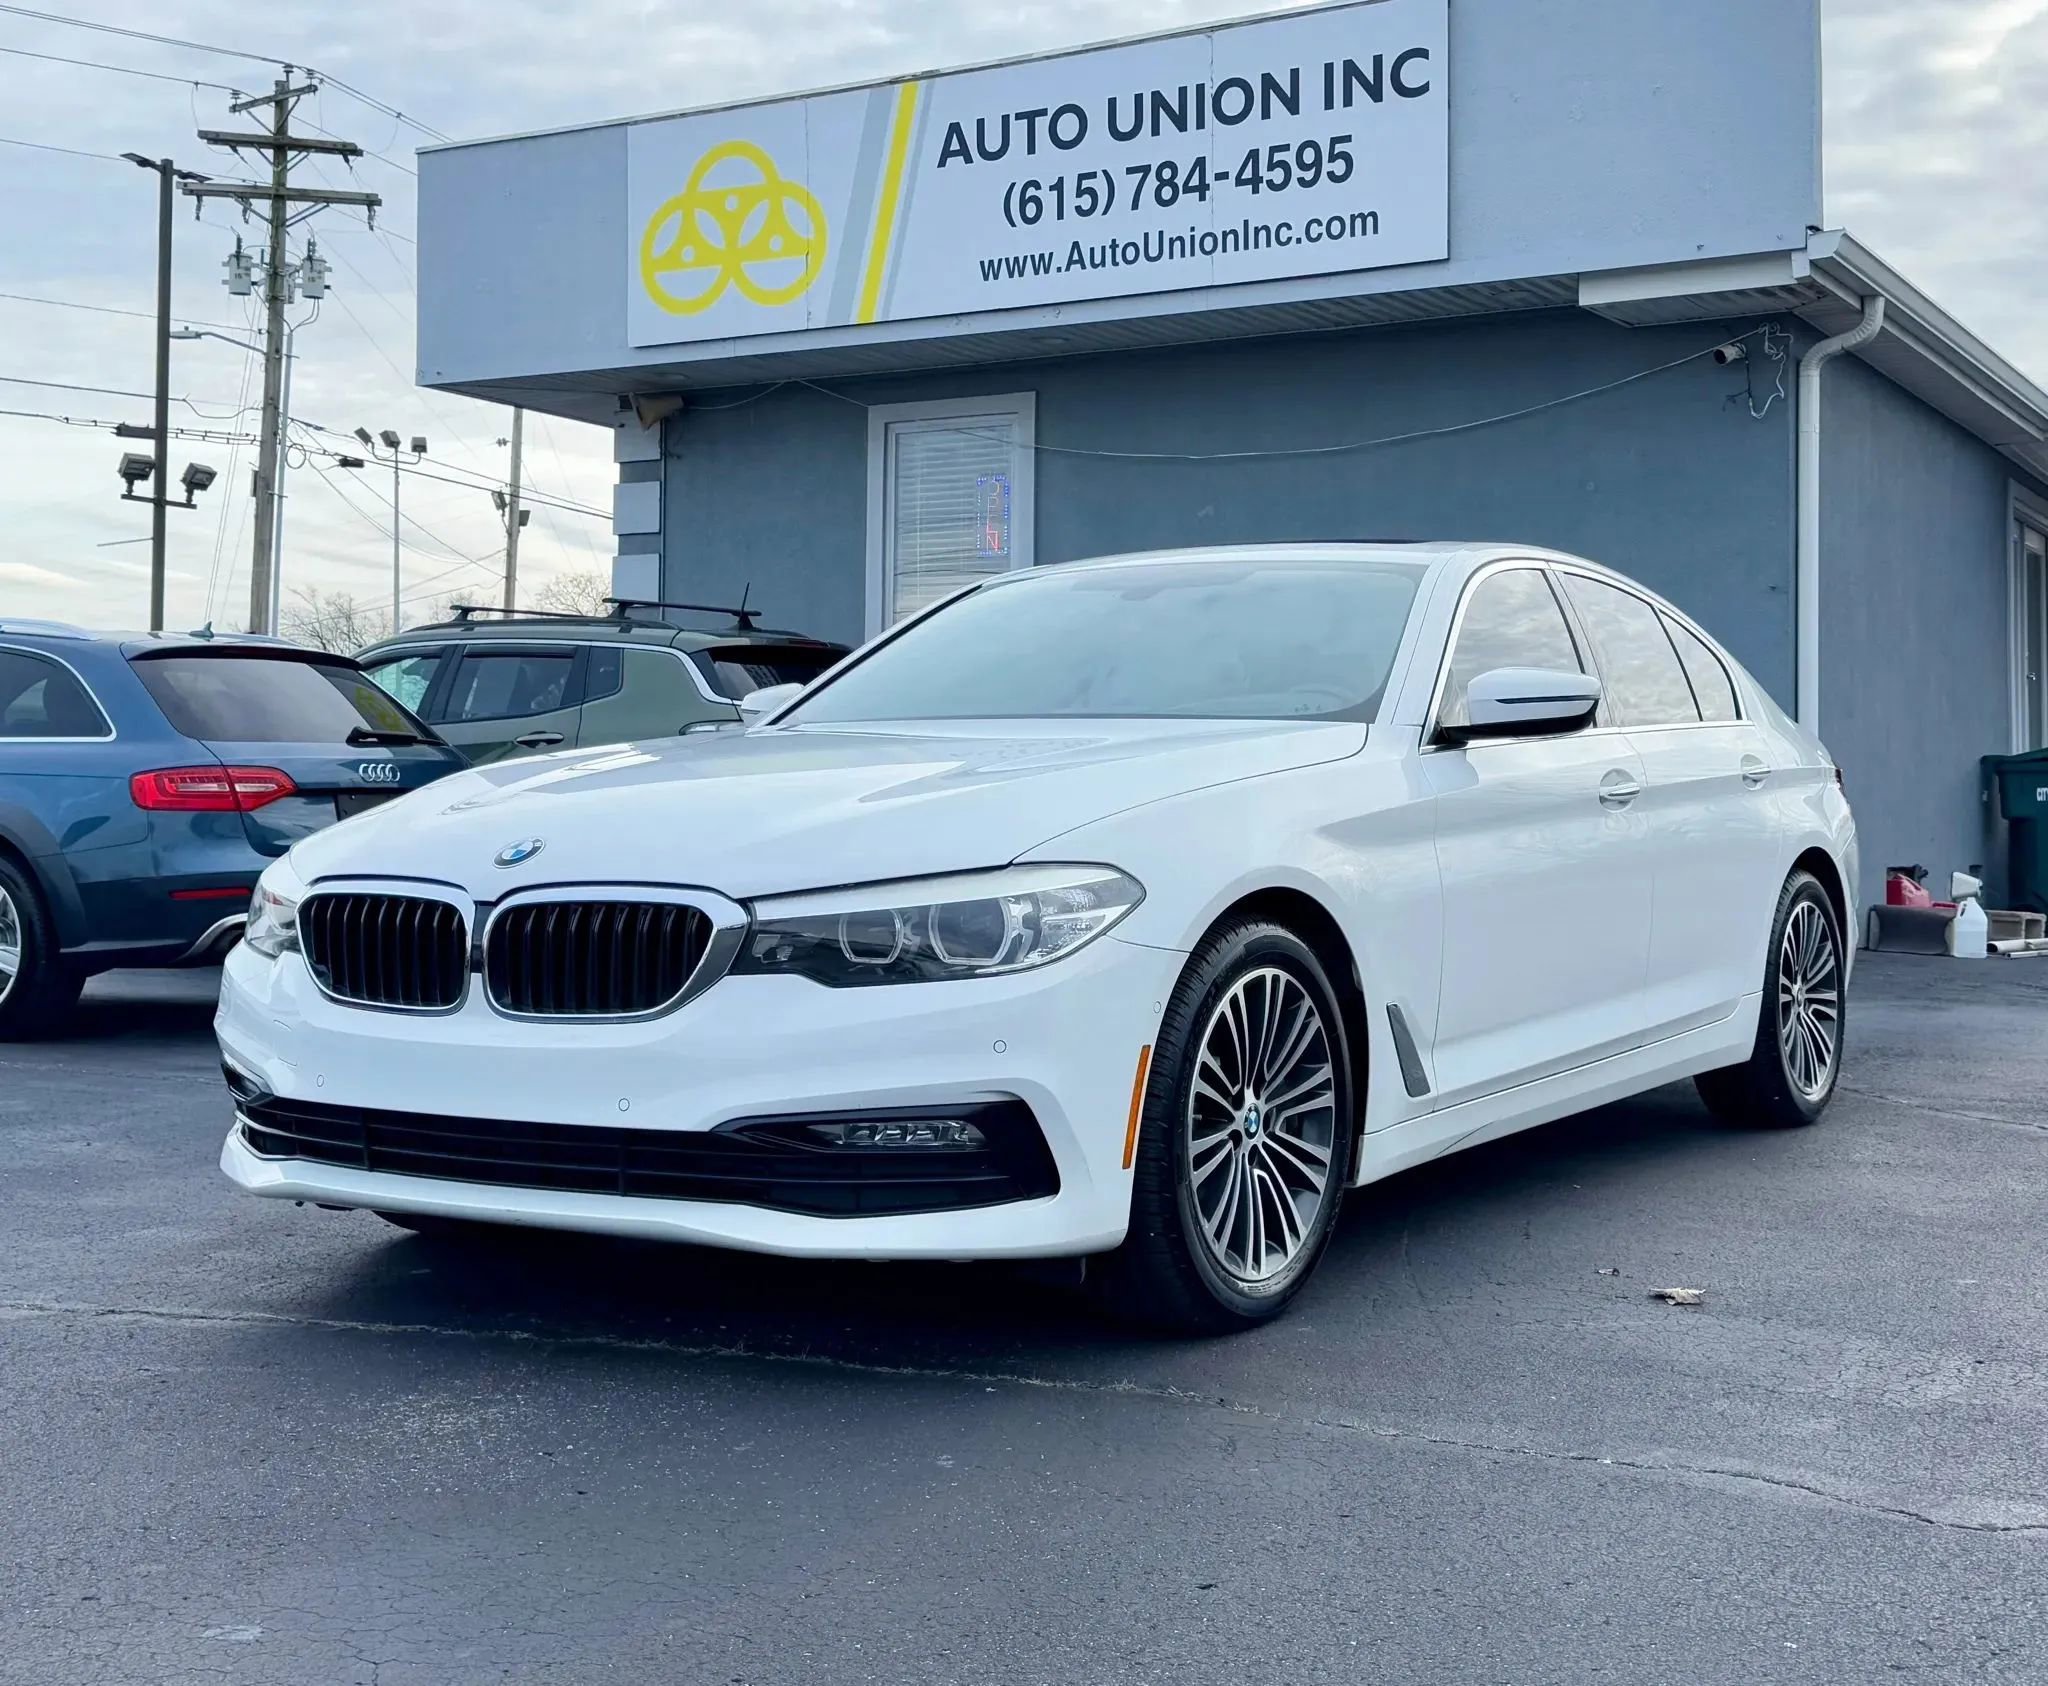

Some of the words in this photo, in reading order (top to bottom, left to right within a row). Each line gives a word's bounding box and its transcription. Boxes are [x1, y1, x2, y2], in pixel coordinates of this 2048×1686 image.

[937, 104, 1088, 168] AUTO
[1108, 68, 1300, 141] UNION
[1324, 48, 1430, 111] INC
[979, 211, 1379, 282] www.AutoUnionInc.com
